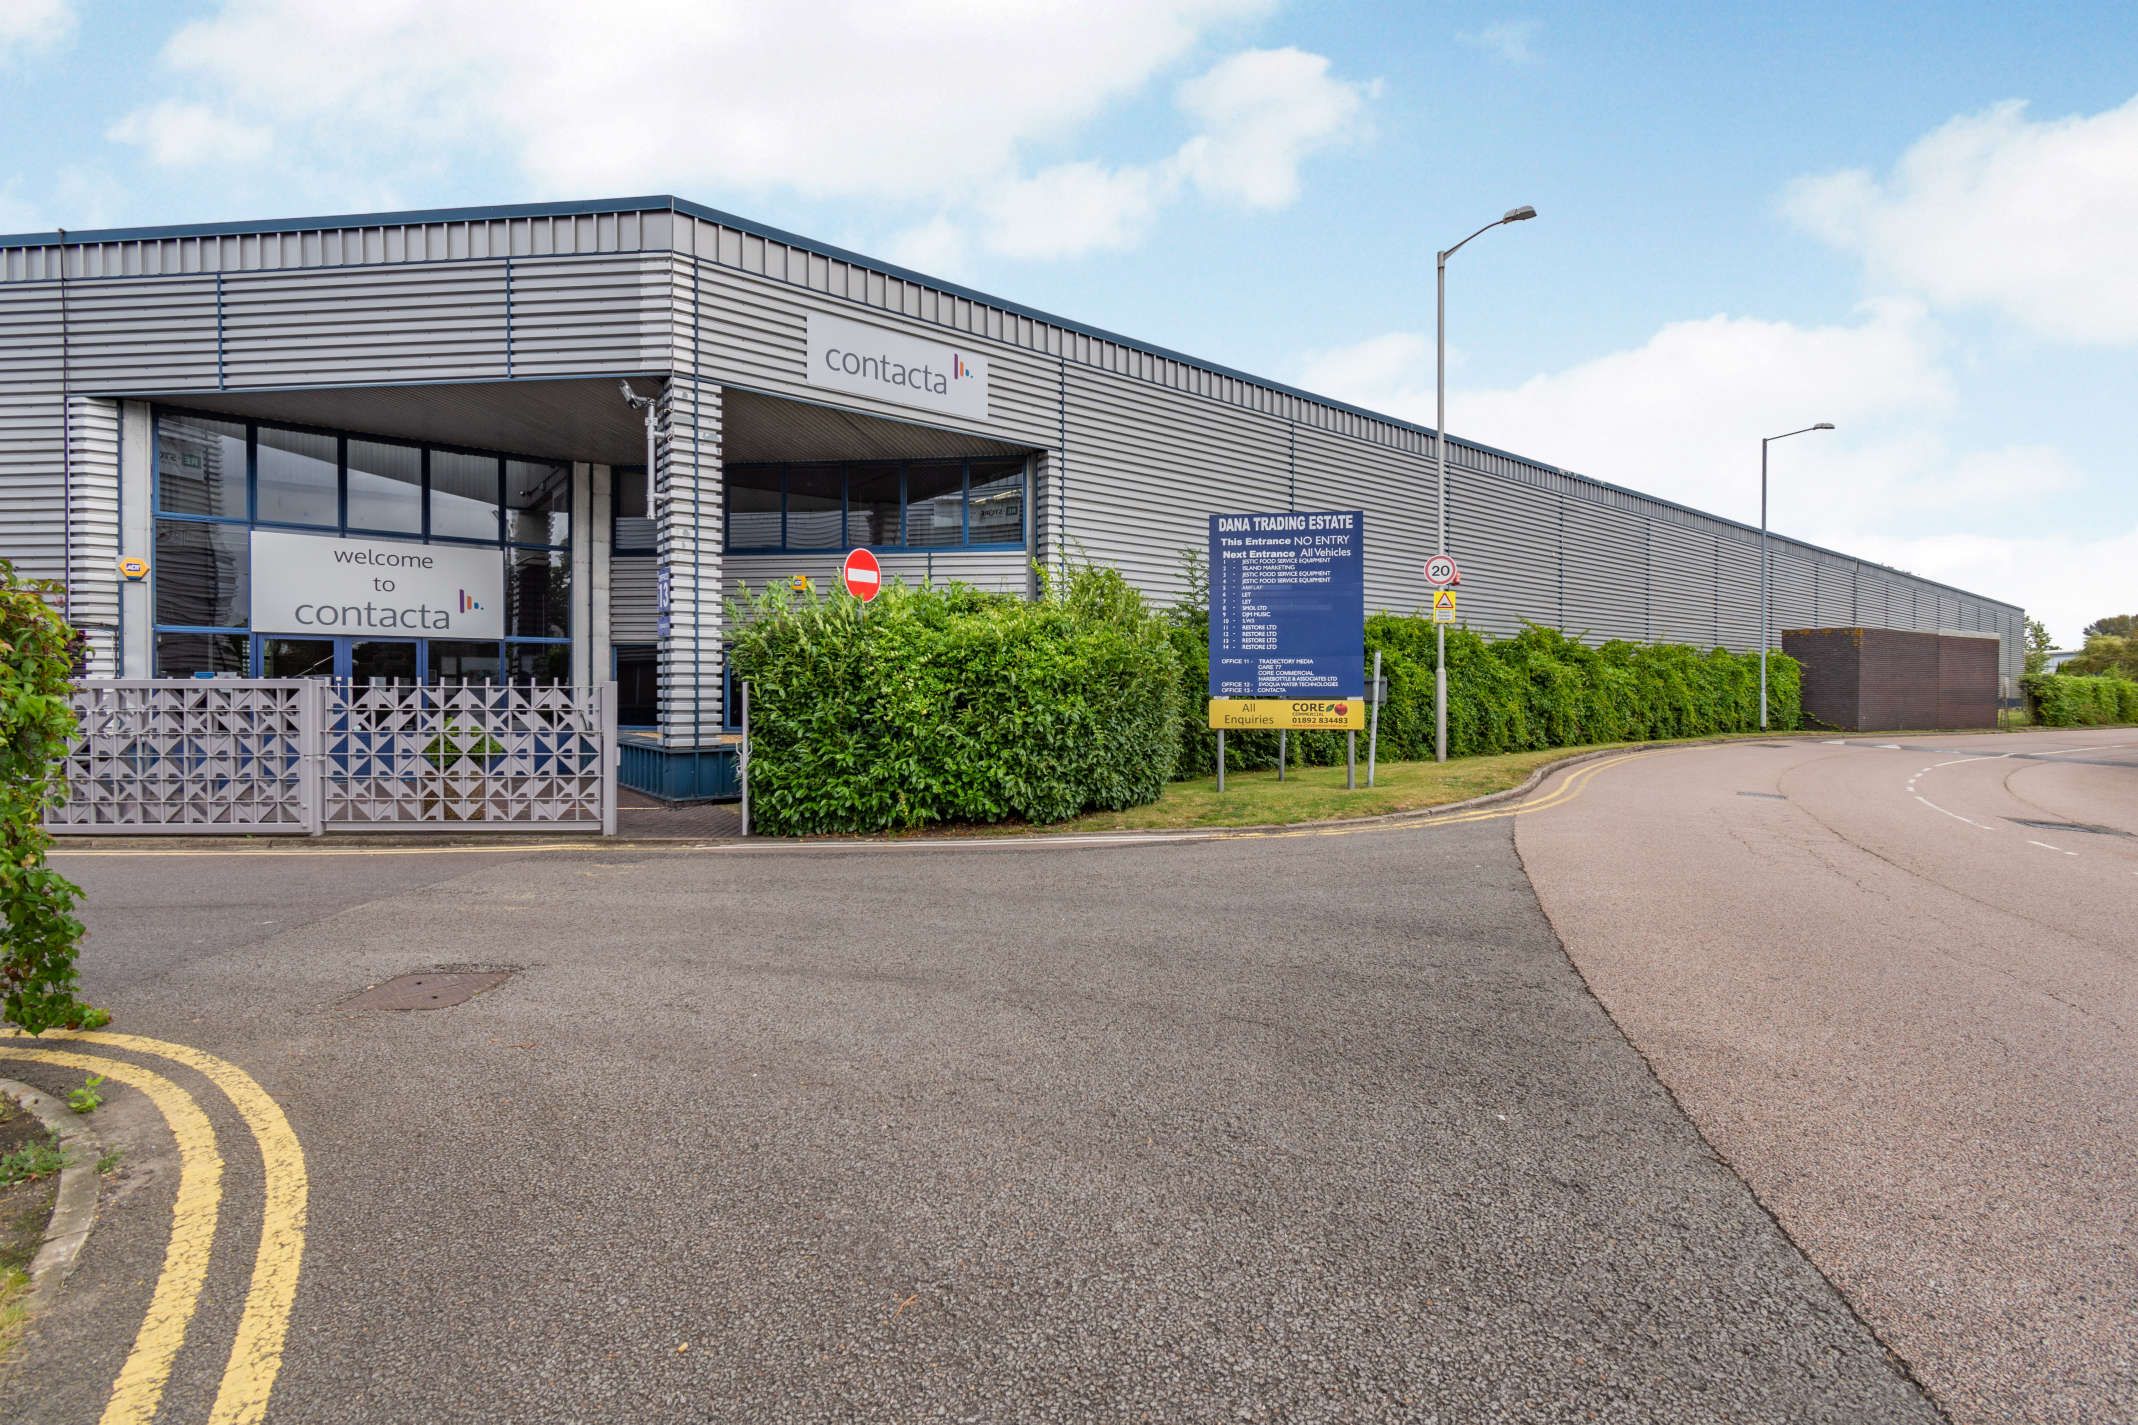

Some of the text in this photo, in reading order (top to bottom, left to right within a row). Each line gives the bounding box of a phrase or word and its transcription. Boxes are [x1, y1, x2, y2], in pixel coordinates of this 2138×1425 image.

[825, 348, 947, 395] contacta
[1219, 515, 1353, 532] DANA TRADING ESTATE
[1245, 537, 1291, 546] Entrance
[1294, 536, 1312, 545] NO
[1316, 535, 1349, 545] ENTRY
[334, 549, 434, 568] welcome
[1223, 551, 1247, 559] Next
[1250, 550, 1295, 558] Entrance
[1316, 548, 1351, 556] Vehicles
[1432, 566, 1450, 576] 20
[374, 577, 395, 592] to
[660, 582, 668, 608] 13
[295, 602, 449, 630] contacta
[1242, 704, 1255, 712] All
[1292, 703, 1324, 712] CORE
[1225, 715, 1274, 725] Enquiries
